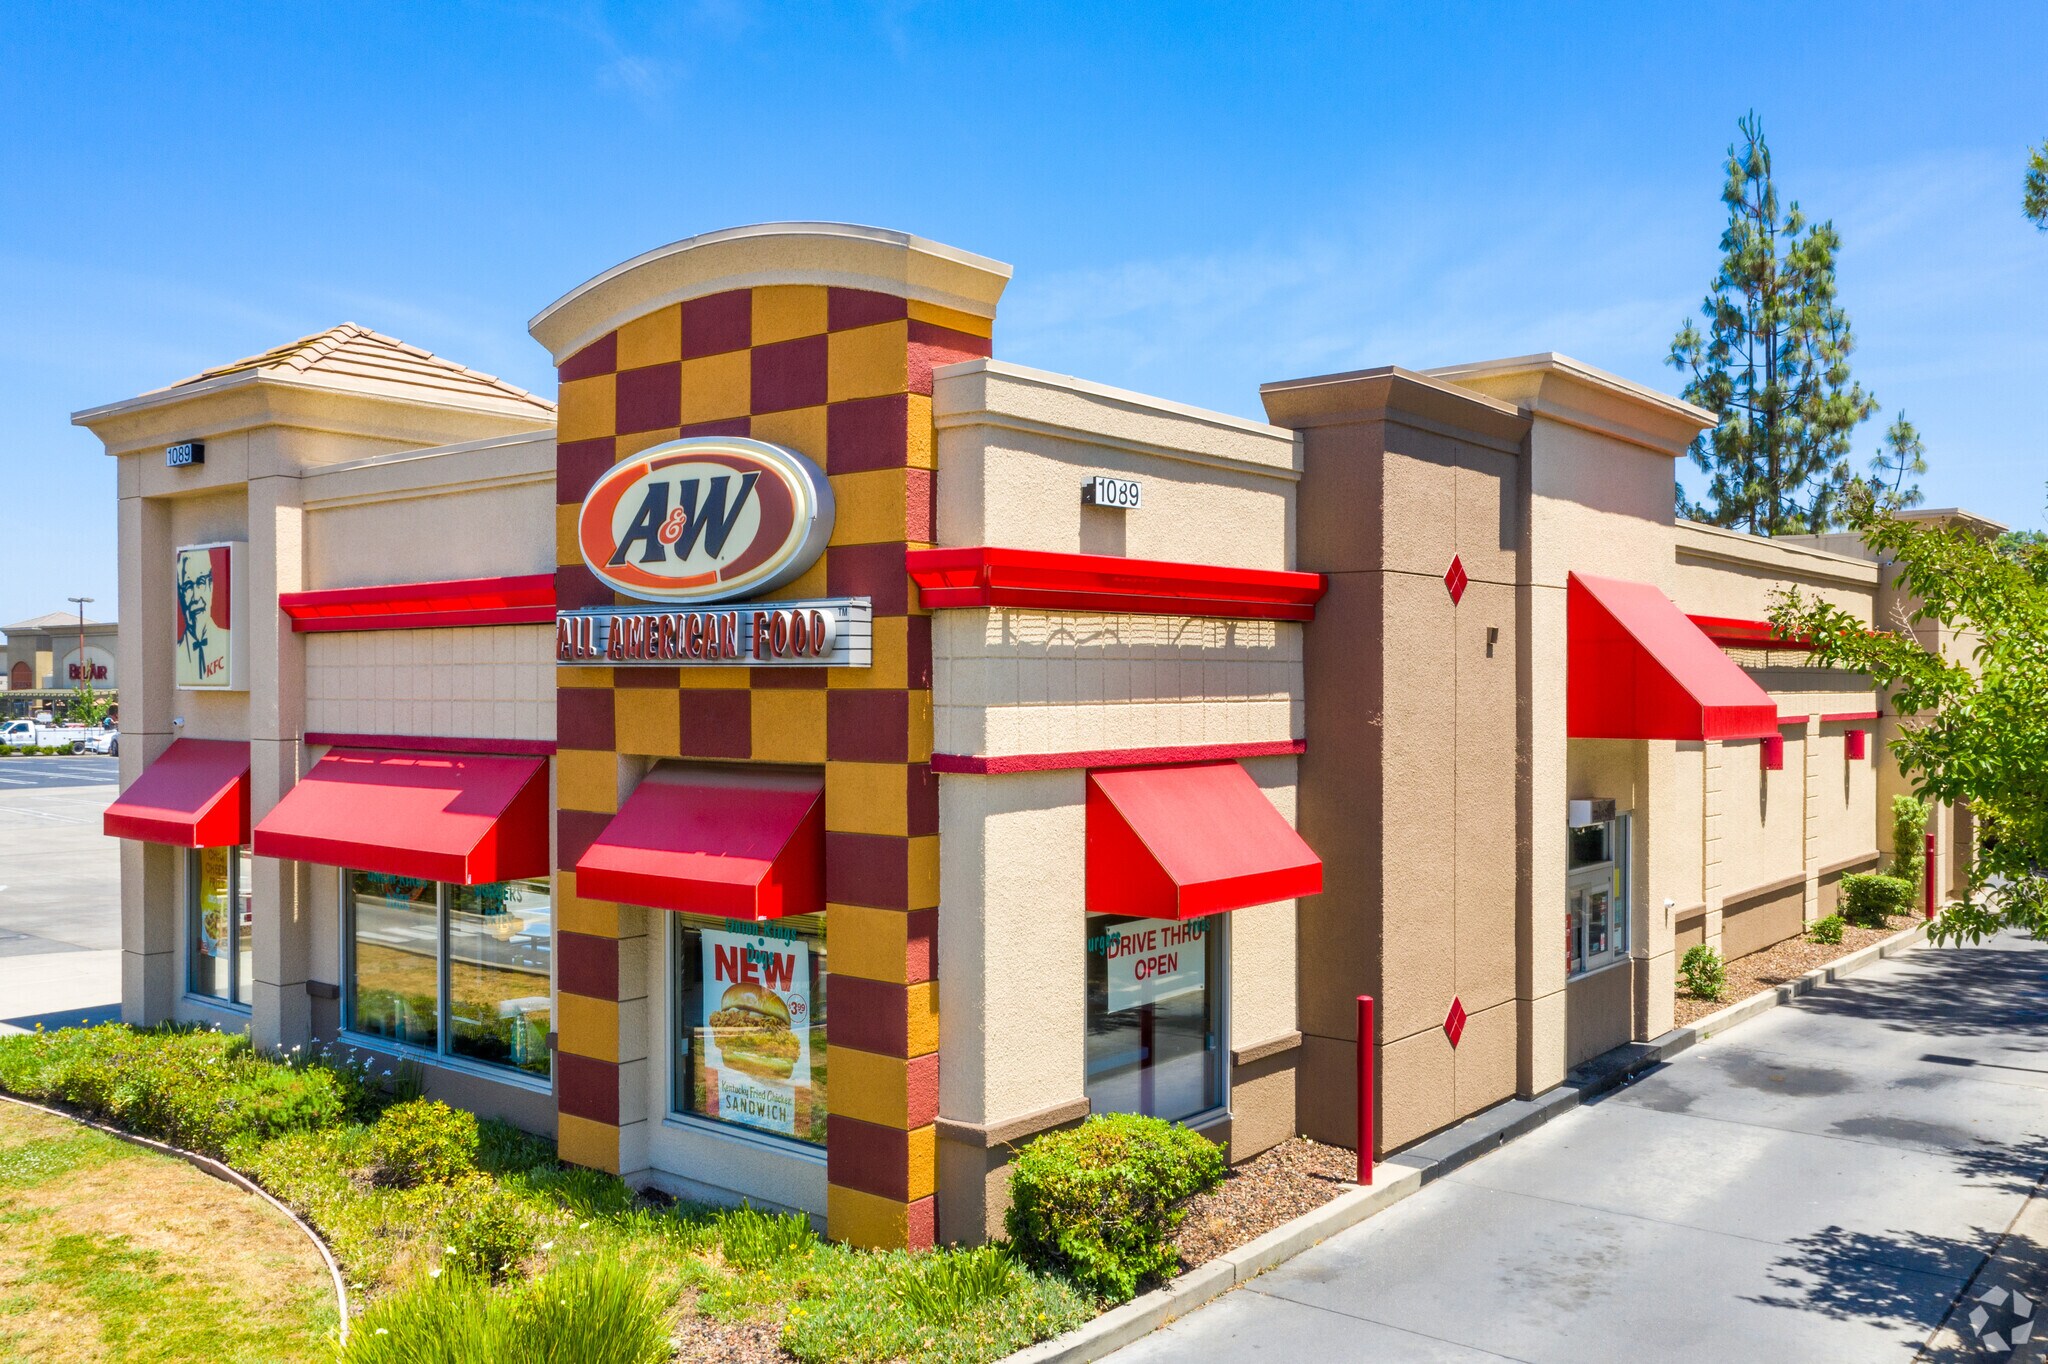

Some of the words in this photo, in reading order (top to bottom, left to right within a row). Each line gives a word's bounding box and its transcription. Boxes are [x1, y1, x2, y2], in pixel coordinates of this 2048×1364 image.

[167, 444, 191, 465] 1089
[1098, 478, 1139, 507] 1089
[608, 472, 760, 566] A&W
[556, 615, 600, 661] ALL
[606, 610, 738, 661] AMERICAN
[752, 609, 833, 660] FOOD
[206, 655, 225, 678] KFC
[763, 920, 798, 948] Rings
[1087, 931, 1121, 956] urgers
[1108, 930, 1157, 959] DRIVE
[1161, 923, 1203, 948] THRU
[714, 943, 796, 992] NEW
[746, 942, 775, 971] Dogs
[1134, 951, 1178, 981] OPEN
[720, 1079, 749, 1099] Kentucky
[749, 1086, 766, 1100] Fried
[725, 1094, 788, 1123] SANDWICH
